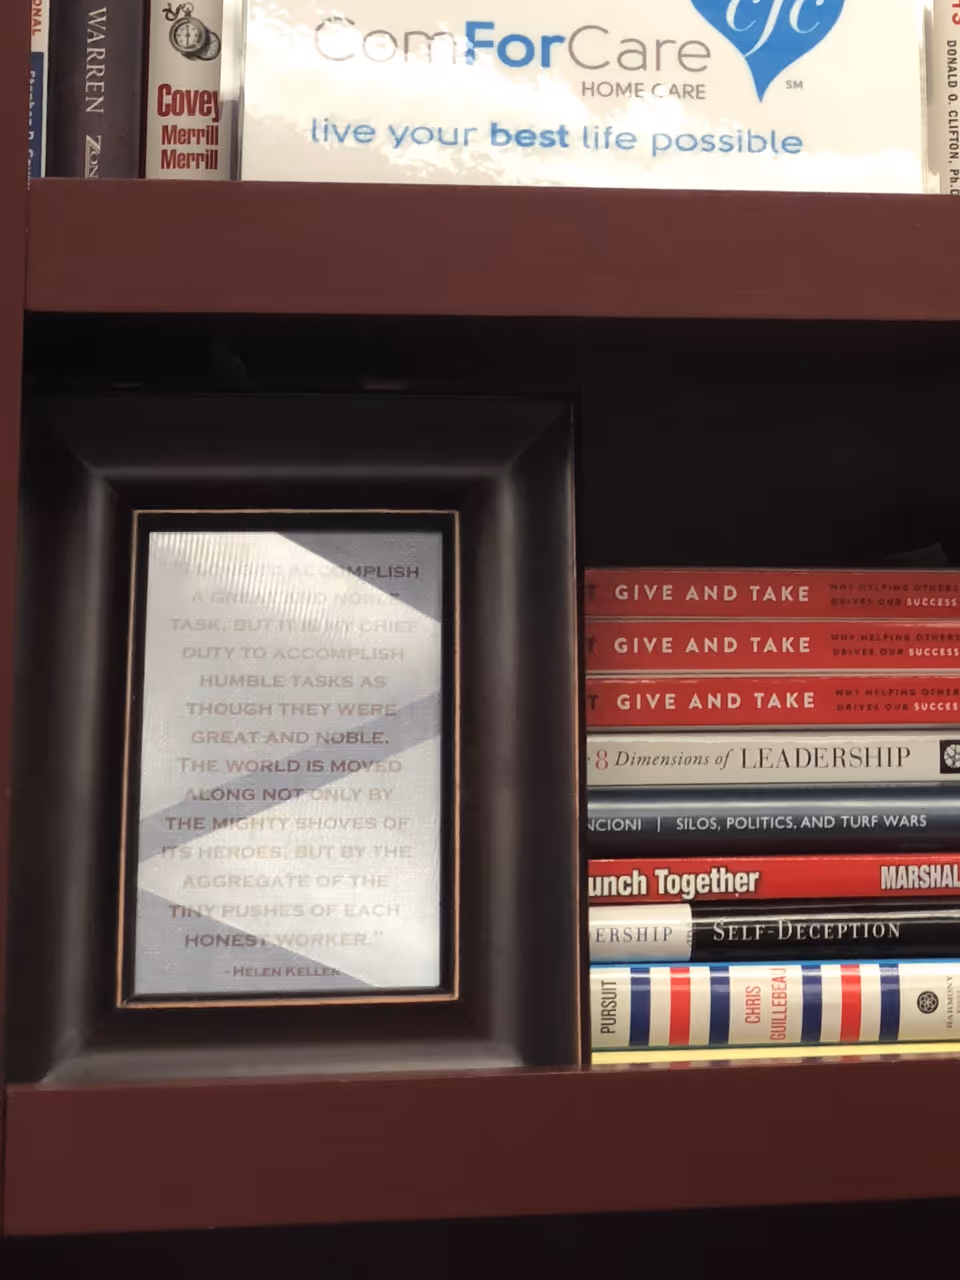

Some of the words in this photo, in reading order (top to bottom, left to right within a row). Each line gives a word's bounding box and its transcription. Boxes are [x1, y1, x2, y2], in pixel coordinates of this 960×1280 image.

[315, 16, 711, 74] ComForCare
[85, 7, 107, 113] WARREN
[581, 80, 645, 98] HOME
[651, 81, 706, 100] CARE
[157, 83, 219, 122] Covey
[160, 124, 219, 146] Merrill
[310, 118, 376, 145] live
[388, 125, 477, 149] your
[490, 122, 569, 148] best
[581, 125, 637, 151] life
[652, 128, 804, 157] possible
[615, 584, 674, 601] GIVE
[686, 585, 738, 601] AND
[749, 586, 810, 602] TAKE
[907, 598, 958, 607] SUCCESS
[191, 731, 260, 745] GREAT
[266, 731, 310, 745] AND
[315, 731, 389, 745] NOBLE.
[226, 760, 301, 772] WORLD
[306, 760, 325, 772] IS
[330, 760, 402, 773] MOVED
[594, 749, 608, 770] 8
[614, 750, 710, 767] Dimensions
[714, 748, 733, 769] of
[740, 747, 911, 770] LEADERSHIP
[185, 788, 256, 801] ALONG
[262, 788, 305, 801] NOT
[676, 817, 720, 832] SILOS,
[726, 816, 798, 830] POLITICS,
[800, 816, 835, 828] AND
[840, 815, 878, 828] TURF
[883, 814, 927, 827] WARS
[655, 868, 760, 900] Together
[185, 934, 274, 947] HONEST
[600, 980, 617, 1034] PURSUIT
